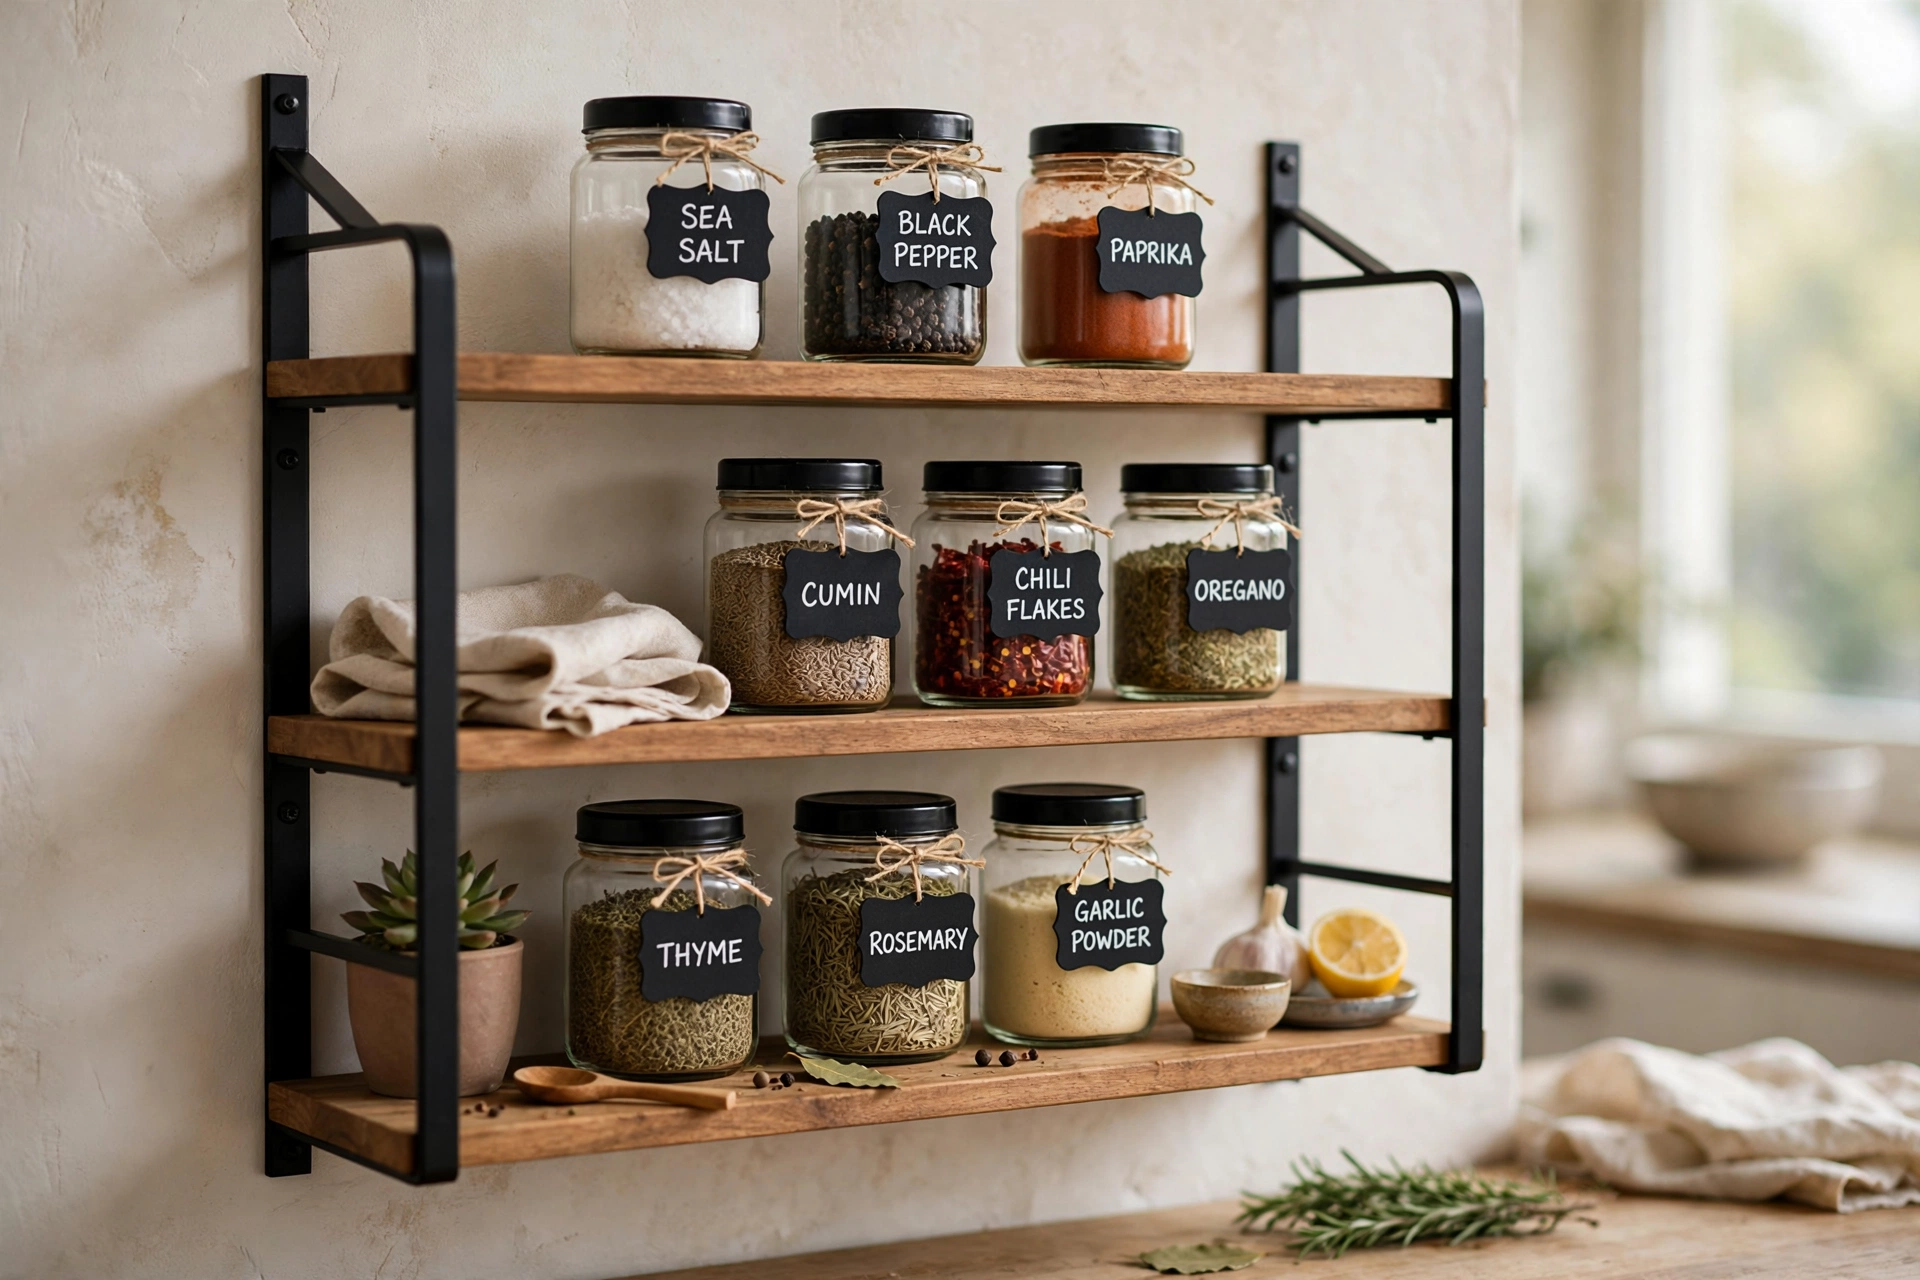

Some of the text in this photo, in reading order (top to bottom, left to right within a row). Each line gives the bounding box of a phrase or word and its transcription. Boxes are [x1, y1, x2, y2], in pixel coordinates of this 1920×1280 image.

[681, 202, 733, 230] SEA
[897, 209, 972, 237] BLACK
[678, 237, 745, 264] SALT
[893, 241, 979, 270] PEPPER
[1110, 237, 1193, 266] PAPRIKA
[1015, 566, 1071, 591] CHILI
[1194, 578, 1286, 602] OREGANO
[801, 581, 881, 608] CUMIN
[1006, 597, 1086, 621] FLAKES
[1074, 896, 1145, 923] GARLIC
[656, 938, 743, 969] THYME
[869, 926, 969, 956] ROSEMARY
[1071, 925, 1152, 954] POWDER
